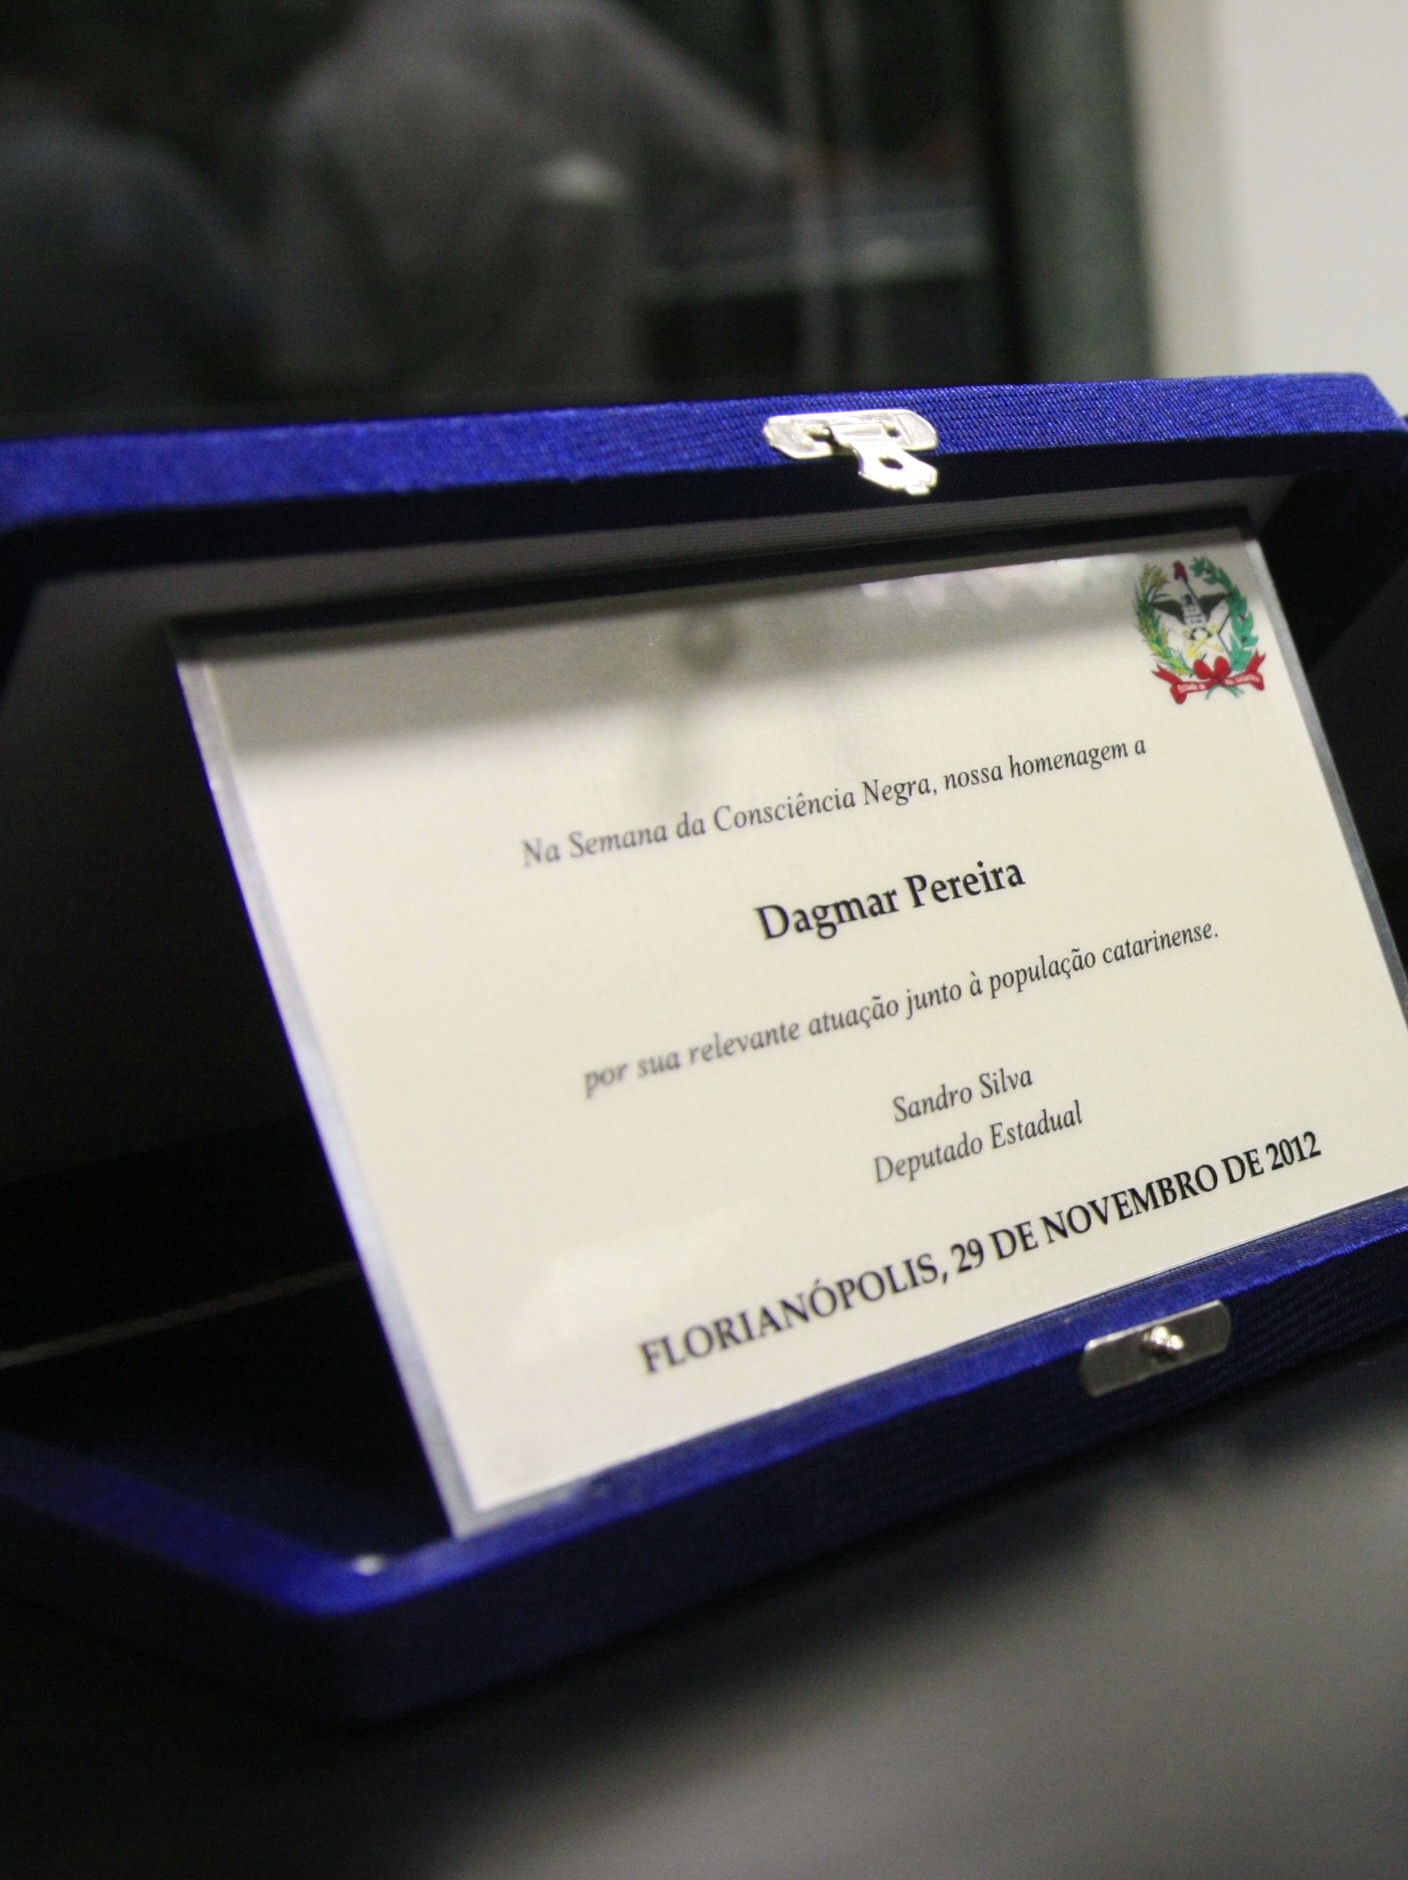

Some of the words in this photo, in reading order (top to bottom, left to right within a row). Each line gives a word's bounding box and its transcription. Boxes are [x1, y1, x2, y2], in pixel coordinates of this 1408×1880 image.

[521, 837, 562, 868] Na
[567, 824, 669, 859] Semana
[675, 810, 707, 840] da
[712, 790, 857, 833] Consciência
[860, 776, 938, 807] Negra,
[942, 764, 1005, 791] nossa
[1007, 741, 1130, 779] homenagem
[1133, 738, 1148, 757] a
[752, 888, 901, 943] Dagmar
[901, 858, 1027, 910] Pereira
[583, 1062, 629, 1100] por
[636, 1051, 682, 1079] sua
[688, 1021, 801, 1066] relevante
[807, 993, 900, 1038] atuação
[905, 982, 963, 1021] junto
[968, 970, 984, 998] à
[987, 946, 1097, 1001] população
[1101, 922, 1219, 965] catarinense.
[872, 1130, 984, 1185] Deputado
[988, 1098, 1084, 1151] Estadual
[891, 1082, 974, 1124] Sandro
[977, 1066, 1035, 1100] Silva
[637, 1252, 950, 1376] FLORIANÓPOLIS,
[949, 1237, 986, 1276] 29
[987, 1219, 1040, 1262] DE
[1038, 1163, 1220, 1246] NOVEMBRO
[1219, 1147, 1266, 1186] DE
[1264, 1129, 1323, 1173] 2012
